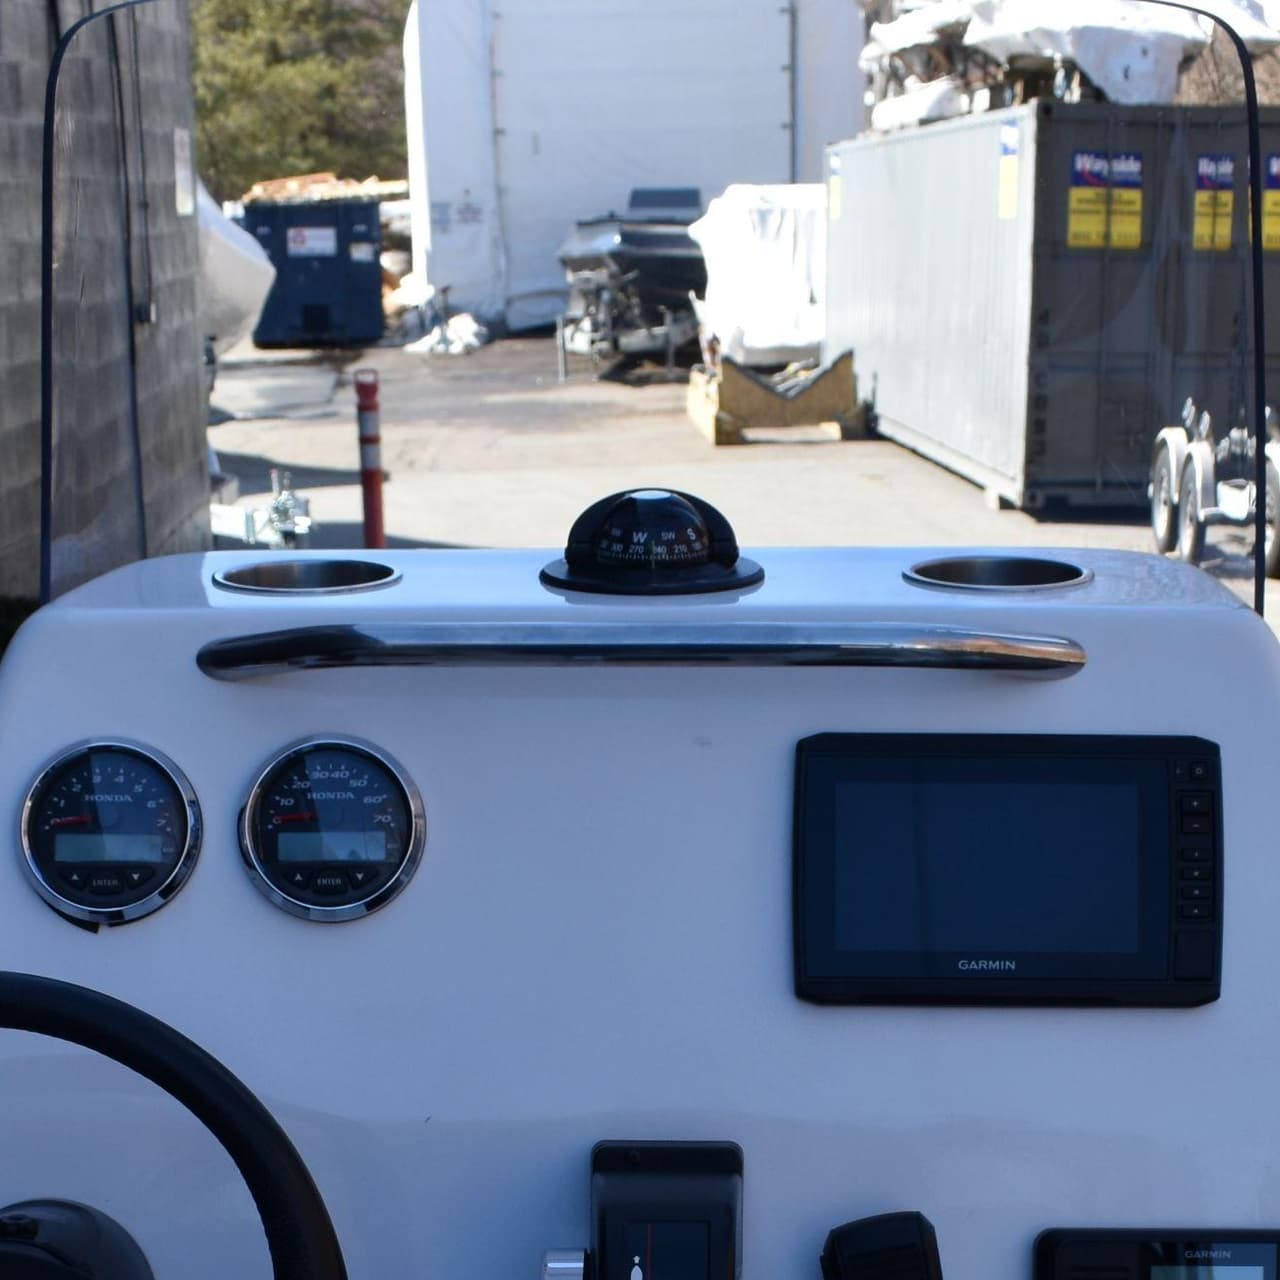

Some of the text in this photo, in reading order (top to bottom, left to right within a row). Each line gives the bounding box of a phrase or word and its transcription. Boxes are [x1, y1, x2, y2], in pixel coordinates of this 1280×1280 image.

[632, 531, 649, 543] W
[686, 527, 697, 541] S
[311, 770, 329, 779] 30
[329, 770, 350, 779] 40
[71, 783, 82, 792] 2
[291, 780, 311, 789] 20
[349, 778, 368, 788] 50
[83, 794, 134, 802] HONDA
[306, 791, 356, 800] HONDA
[362, 795, 382, 804] 60
[279, 797, 295, 807] 10
[372, 814, 392, 824] 70
[92, 879, 120, 887] ENTER
[317, 878, 342, 886] ENTER
[957, 959, 1017, 971] GARMIN
[1183, 1249, 1233, 1259] GARMIN
